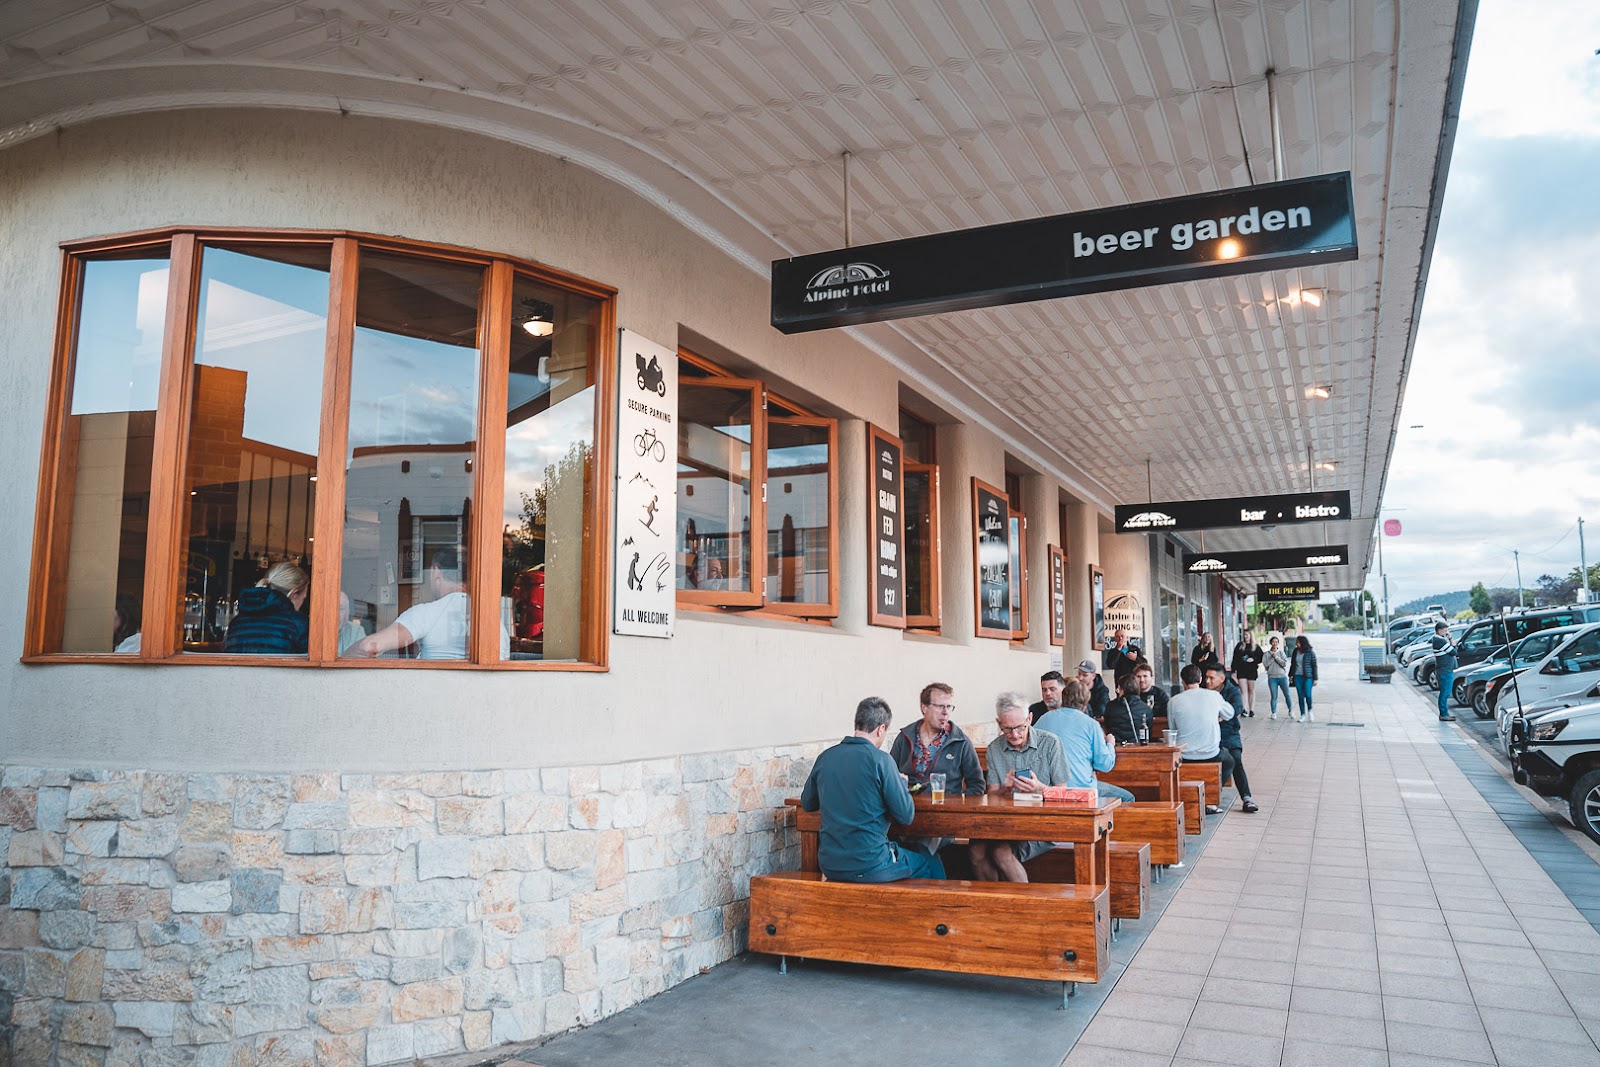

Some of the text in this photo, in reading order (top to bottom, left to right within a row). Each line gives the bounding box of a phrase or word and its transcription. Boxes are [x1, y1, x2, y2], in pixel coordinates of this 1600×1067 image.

[1073, 205, 1312, 258] beer garden
[803, 280, 890, 303] Alpine Hotel
[628, 398, 671, 424] SECURE PARKING
[879, 489, 897, 514] GRAIN
[1240, 504, 1340, 521] bar bistro
[883, 515, 894, 536] FED
[880, 538, 897, 562] RUMP
[1306, 555, 1341, 565] rooms
[1283, 587, 1295, 595] PIE
[1295, 586, 1316, 594] SHOP
[622, 608, 669, 626] ALL WELCOME
